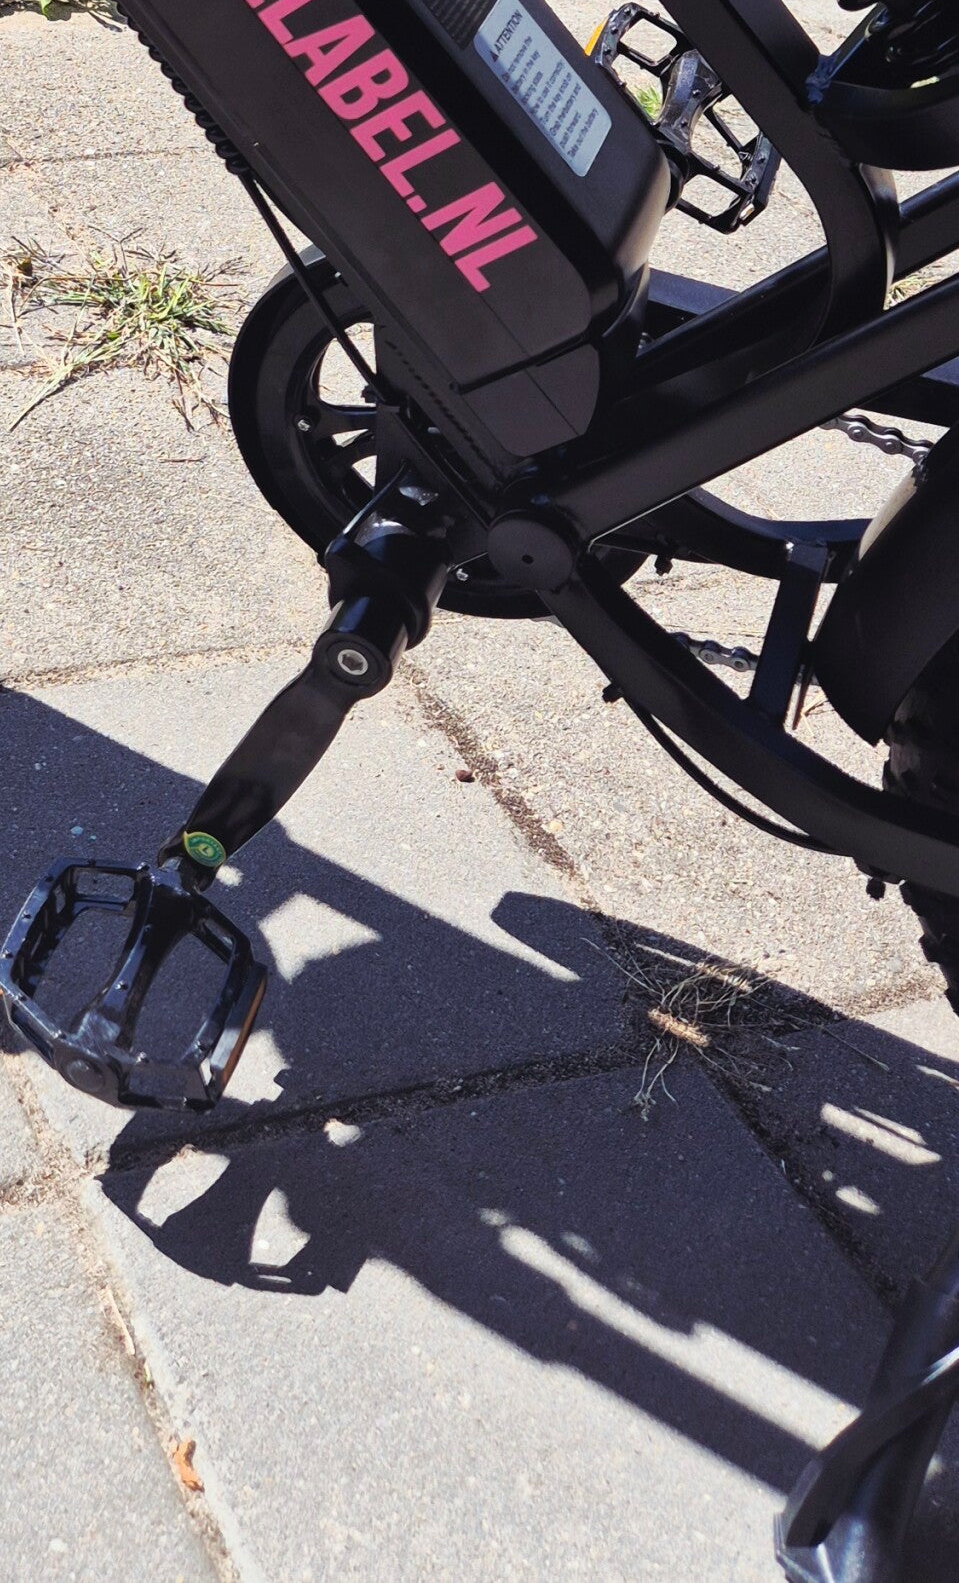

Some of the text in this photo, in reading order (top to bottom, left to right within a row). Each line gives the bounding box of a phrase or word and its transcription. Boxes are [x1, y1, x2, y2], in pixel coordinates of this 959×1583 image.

[494, 8, 523, 55] ATTENTION
[530, 49, 541, 60] key
[584, 106, 598, 128] battery
